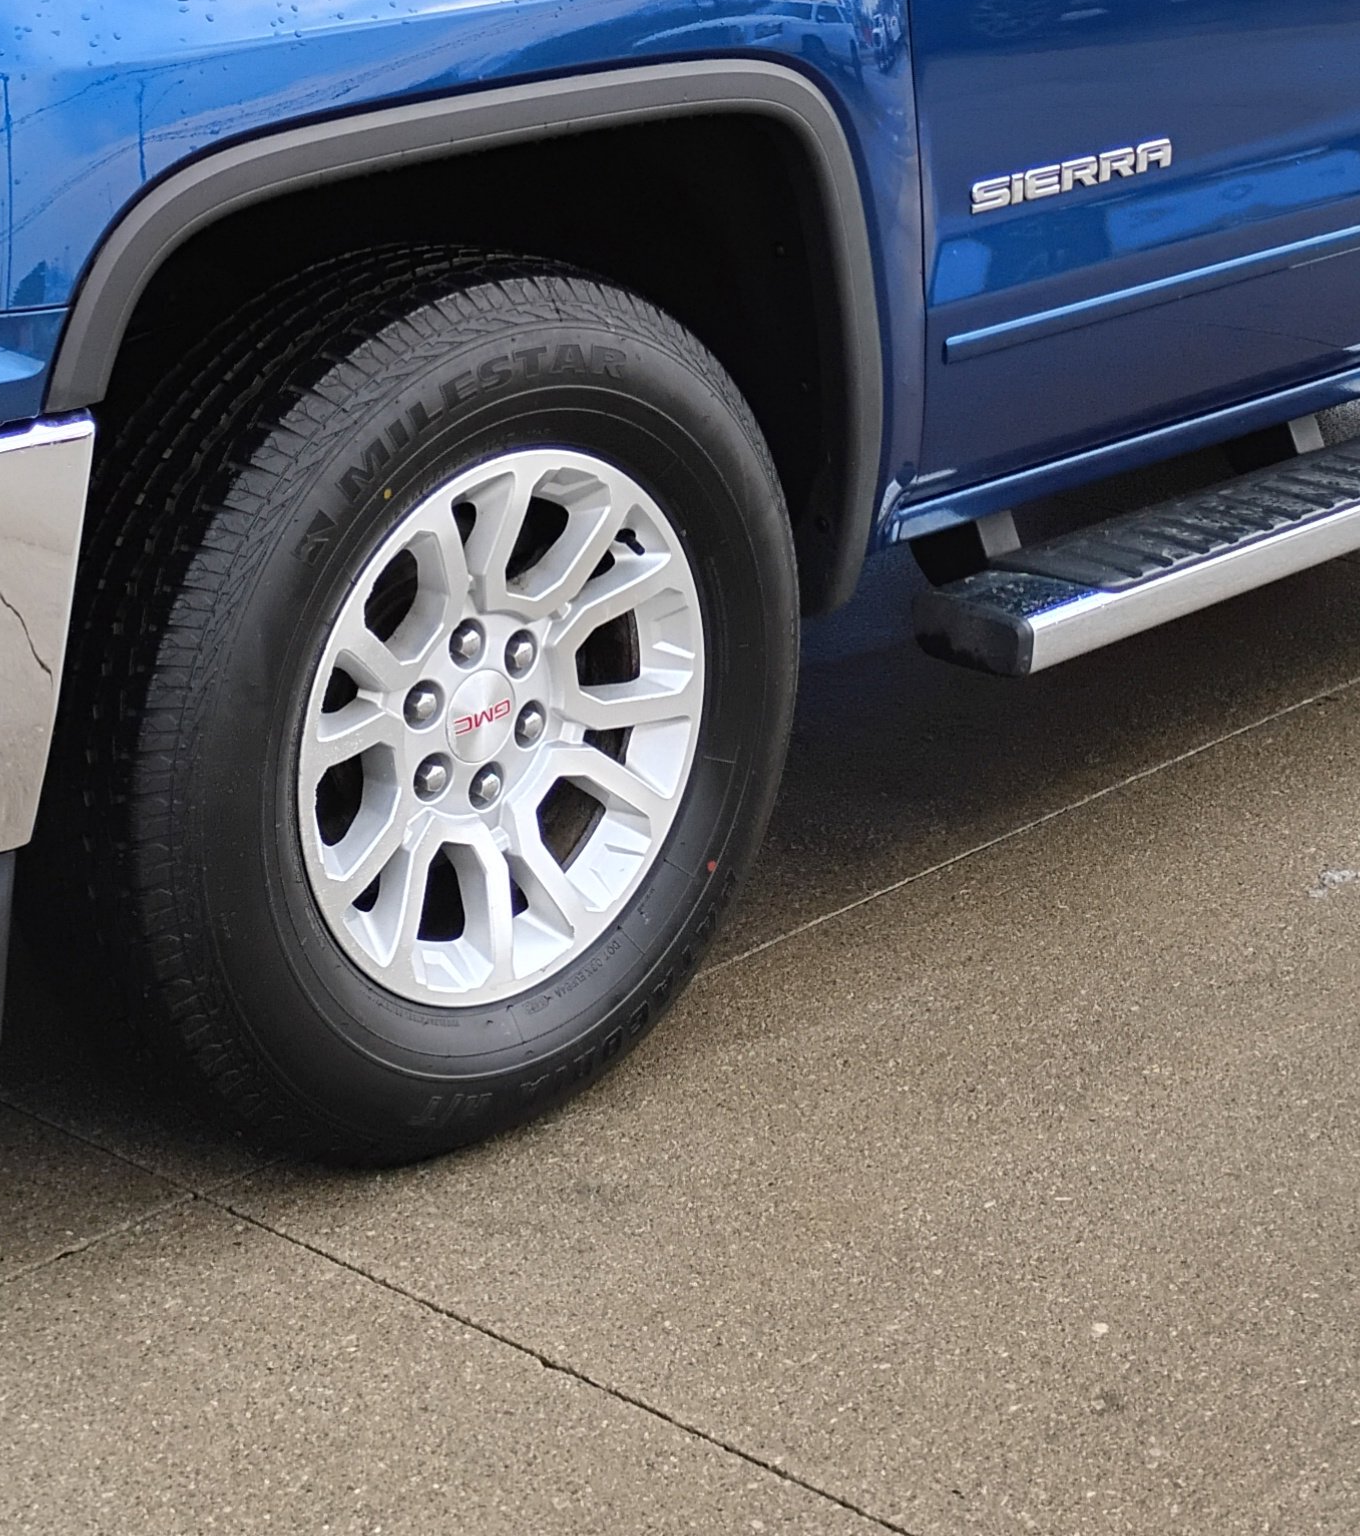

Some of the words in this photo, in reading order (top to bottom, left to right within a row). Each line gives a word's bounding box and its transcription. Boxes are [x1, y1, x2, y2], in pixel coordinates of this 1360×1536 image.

[970, 137, 1173, 214] SIERRA
[335, 342, 628, 506] MILESTAR
[453, 698, 511, 736] GMC
